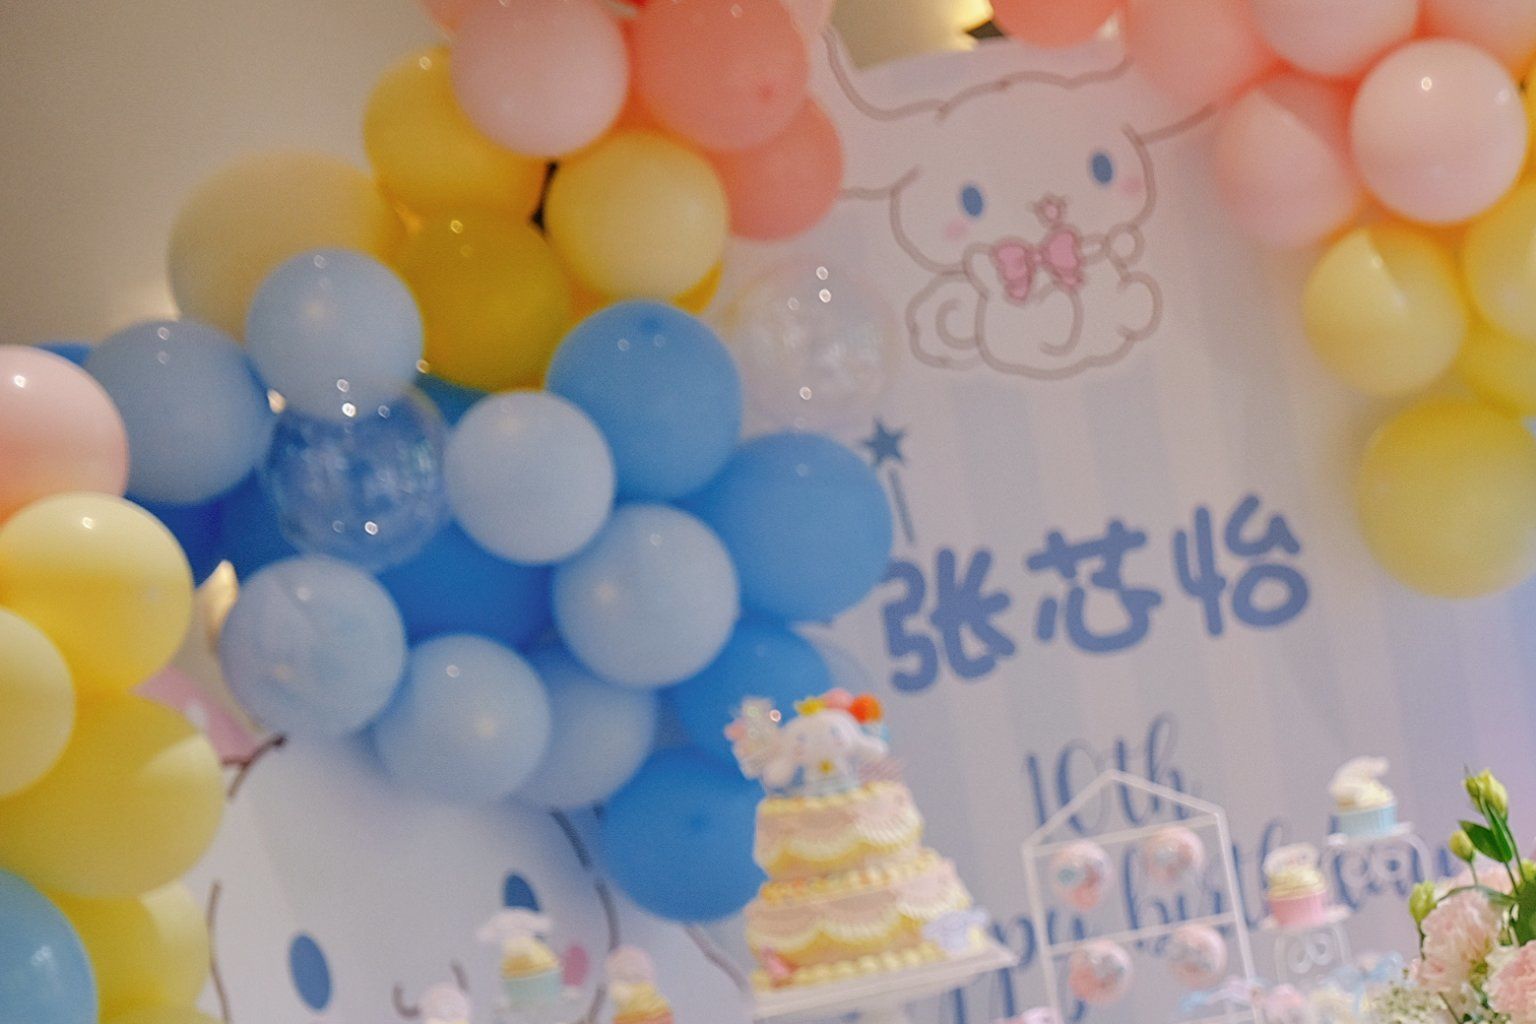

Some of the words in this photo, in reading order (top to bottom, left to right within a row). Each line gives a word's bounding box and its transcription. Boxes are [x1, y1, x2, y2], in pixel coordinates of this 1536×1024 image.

[880, 493, 1310, 692] 张芯怡
[1024, 712, 1200, 833] 10th
